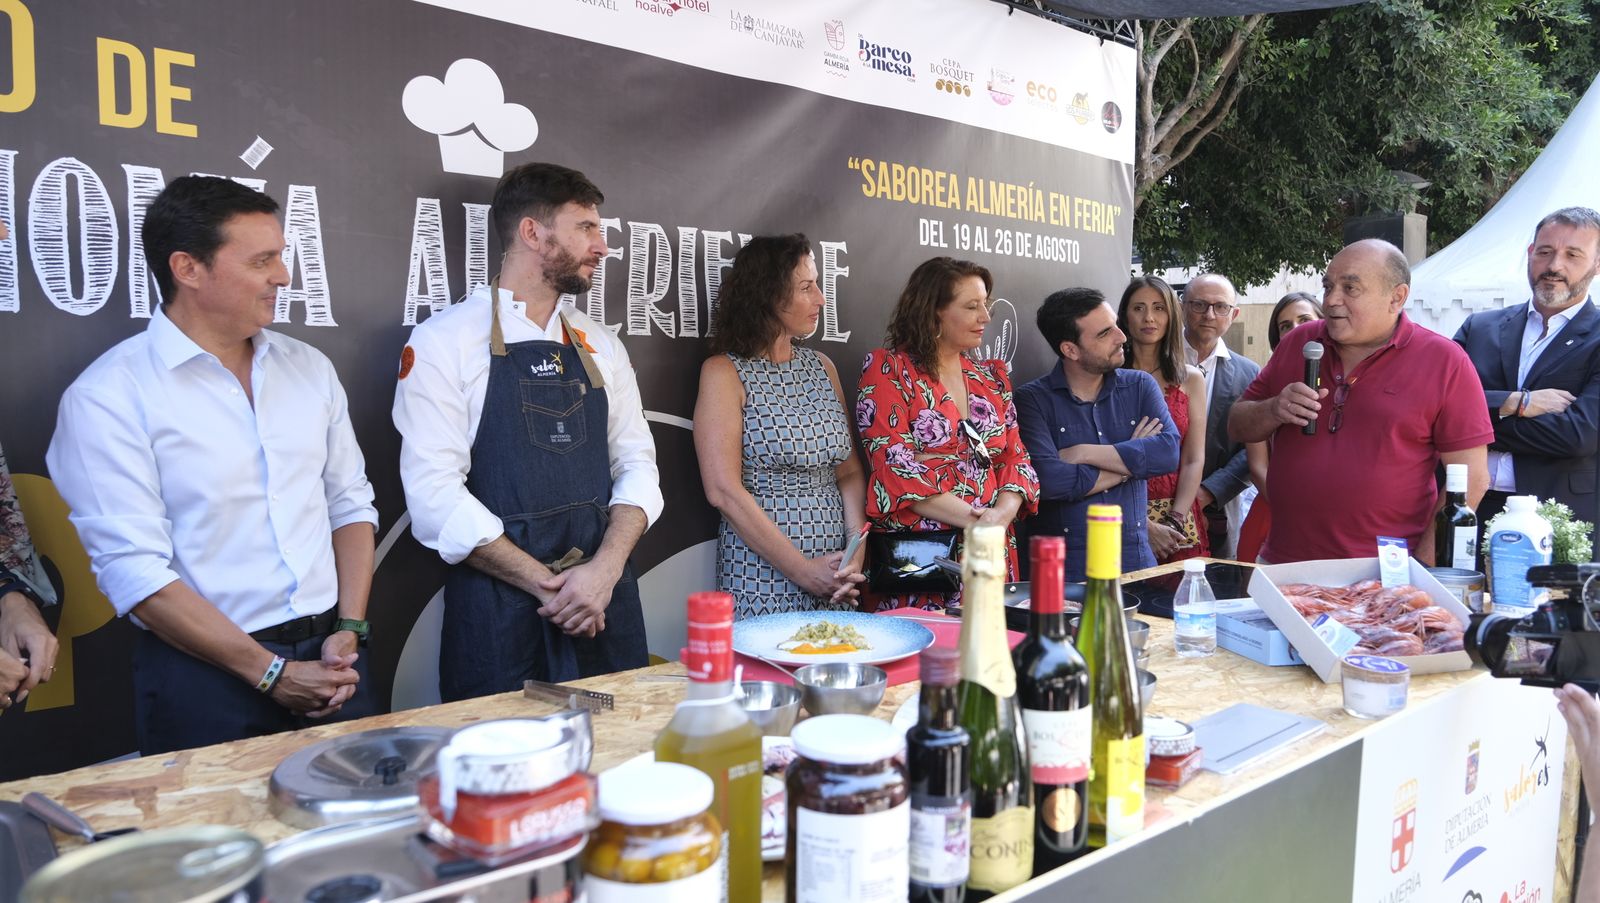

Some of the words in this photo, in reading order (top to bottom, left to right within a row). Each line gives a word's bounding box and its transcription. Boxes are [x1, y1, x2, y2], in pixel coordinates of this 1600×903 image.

[730, 9, 743, 22] LA
[755, 18, 804, 39] ALMAZARA
[730, 20, 743, 32] DE
[754, 29, 805, 49] CANJAYAR
[824, 58, 850, 71] ALMERÍA
[858, 38, 912, 64] Barco
[942, 58, 962, 69] CEPA
[929, 63, 975, 82] BOSQUET
[97, 37, 198, 138] DE
[1026, 80, 1057, 102] eco
[966, 176, 1046, 224] ALMERÍA
[1049, 192, 1070, 227] EN
[919, 218, 948, 248] DEL
[953, 223, 970, 251] 19
[974, 226, 992, 254] AL
[995, 228, 1013, 256] 26
[1016, 231, 1032, 259] DE
[1035, 234, 1080, 265] AGOSTO
[403, 197, 852, 343] ALERIEE
[1515, 880, 1526, 900] La
